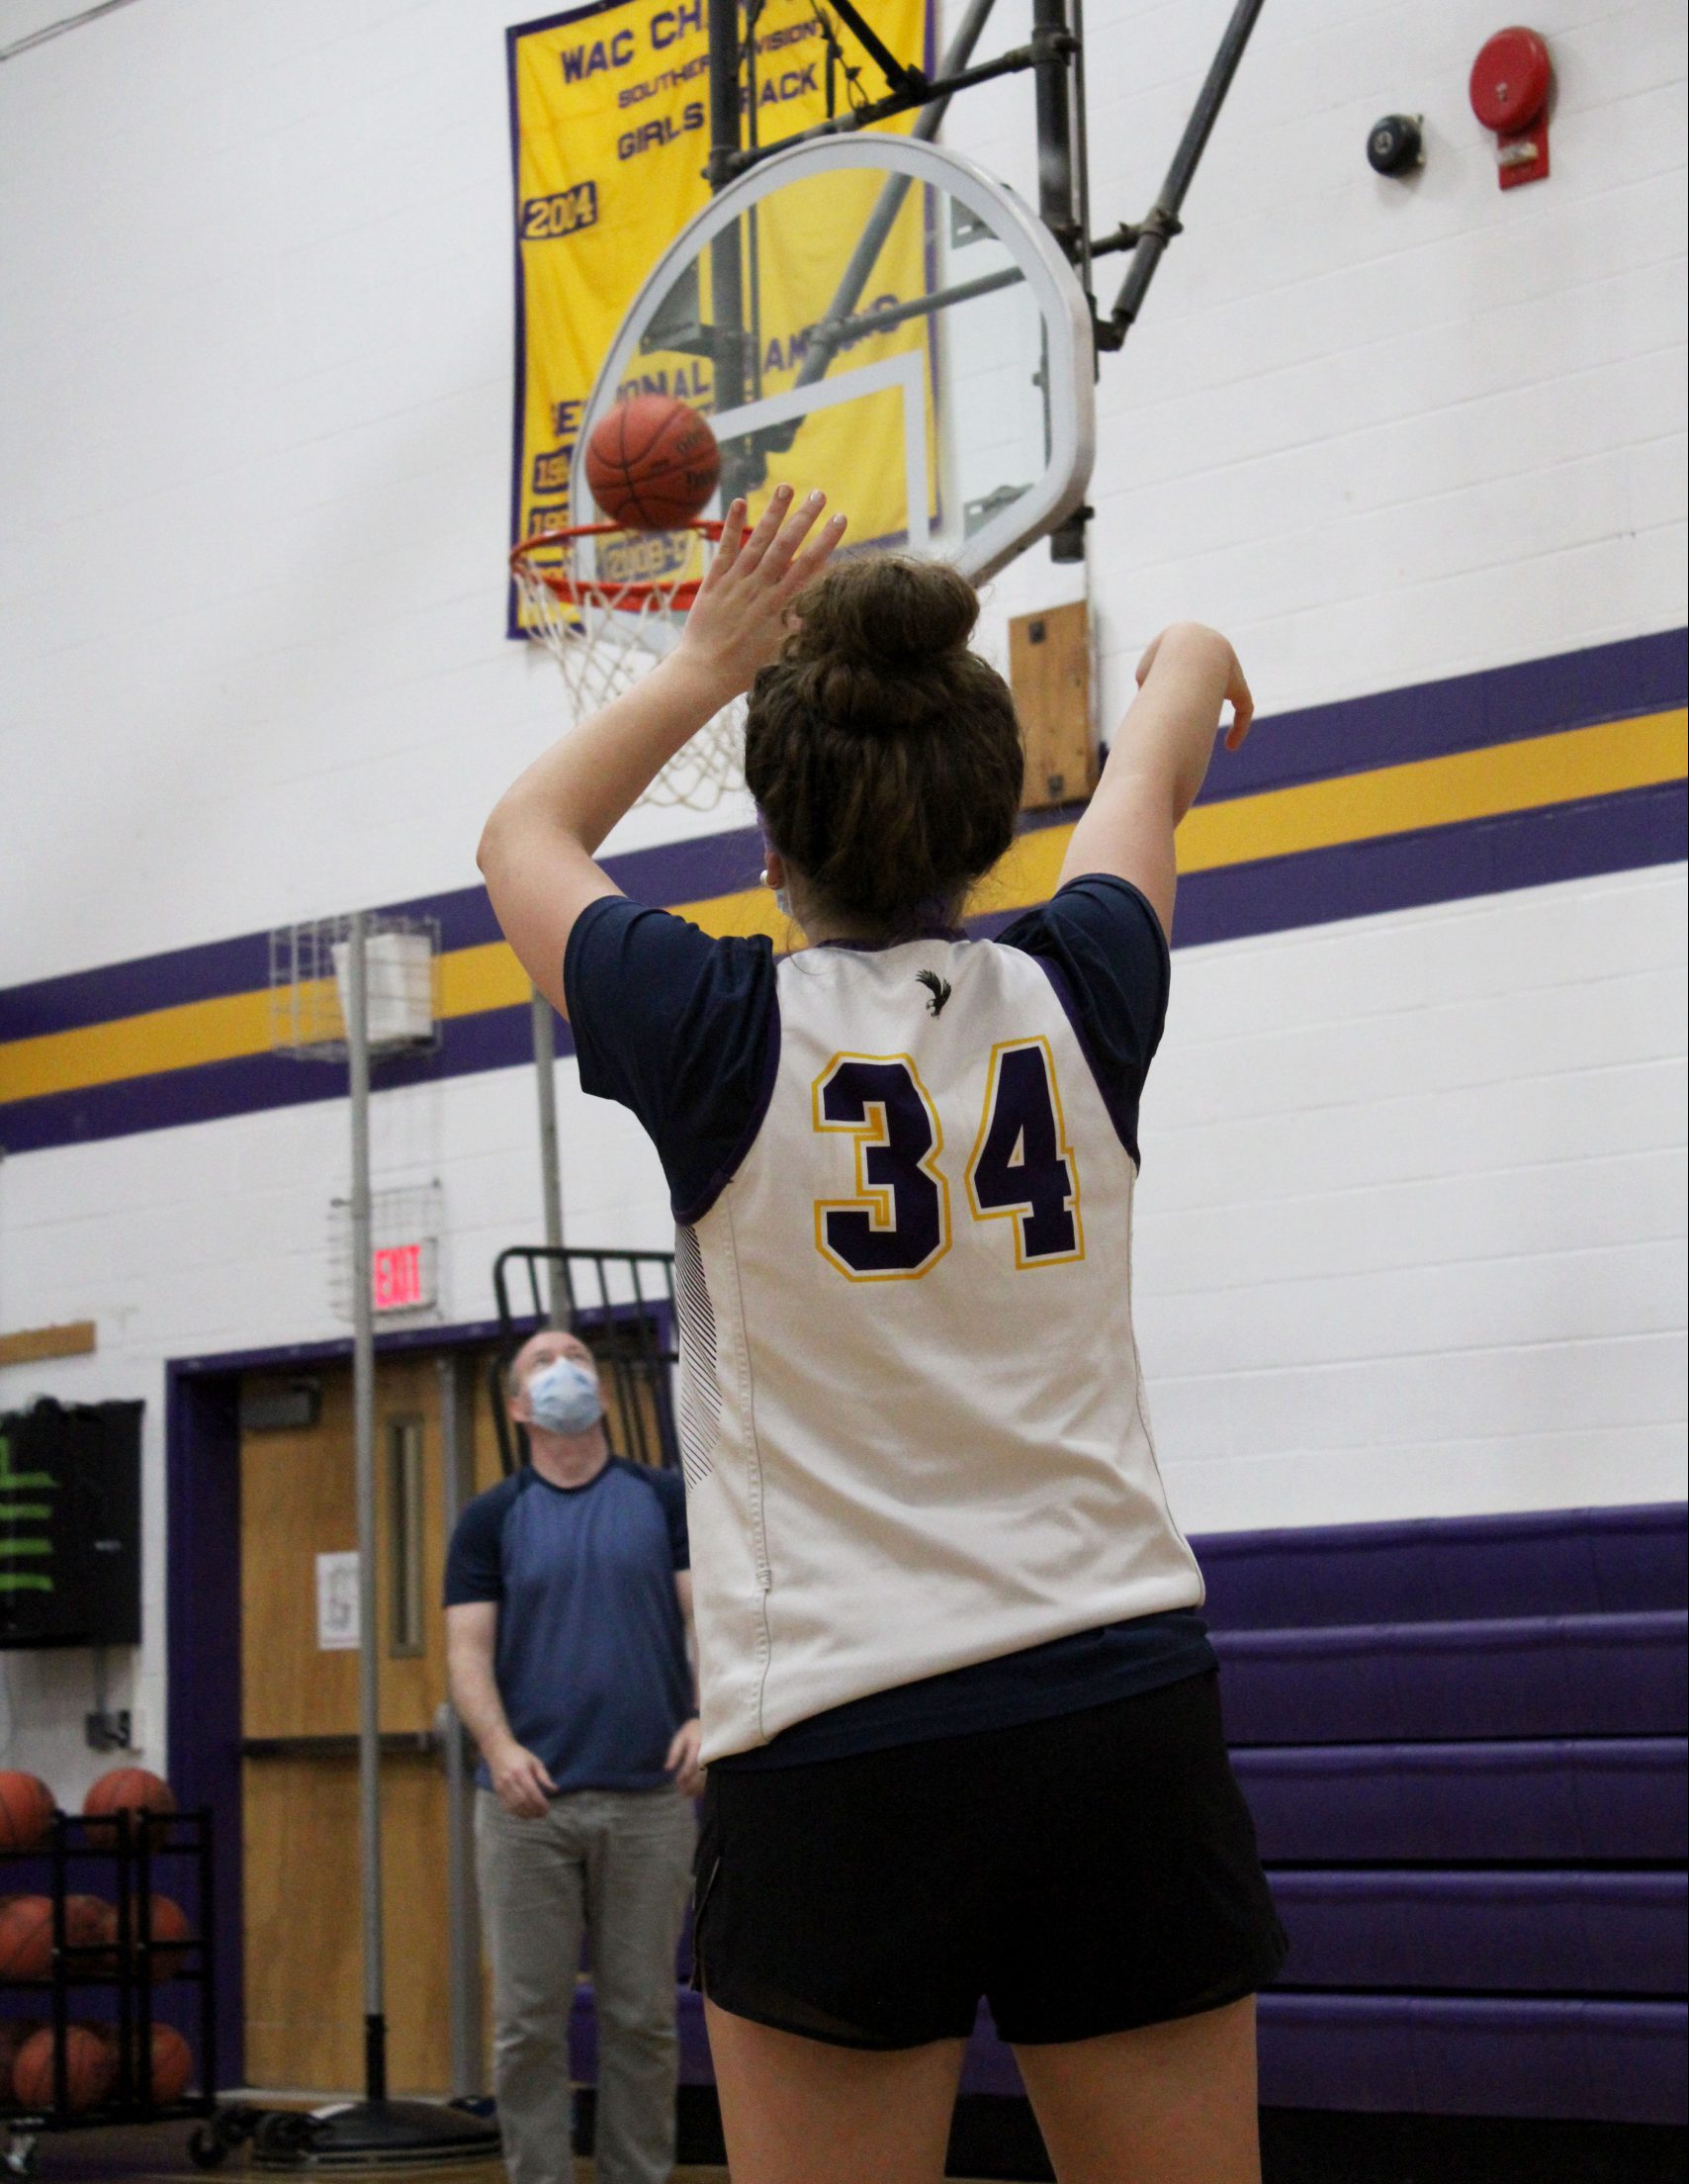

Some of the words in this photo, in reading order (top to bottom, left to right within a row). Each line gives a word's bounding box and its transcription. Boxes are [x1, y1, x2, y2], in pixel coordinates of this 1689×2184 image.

[561, 29, 635, 85] WAC
[617, 53, 711, 109] SOUTHER
[617, 102, 705, 161] GIRLS
[739, 61, 819, 114] RACK
[525, 183, 595, 238] 2014
[811, 1035, 1086, 1283] 34
[373, 1242, 422, 1310] EXIT
